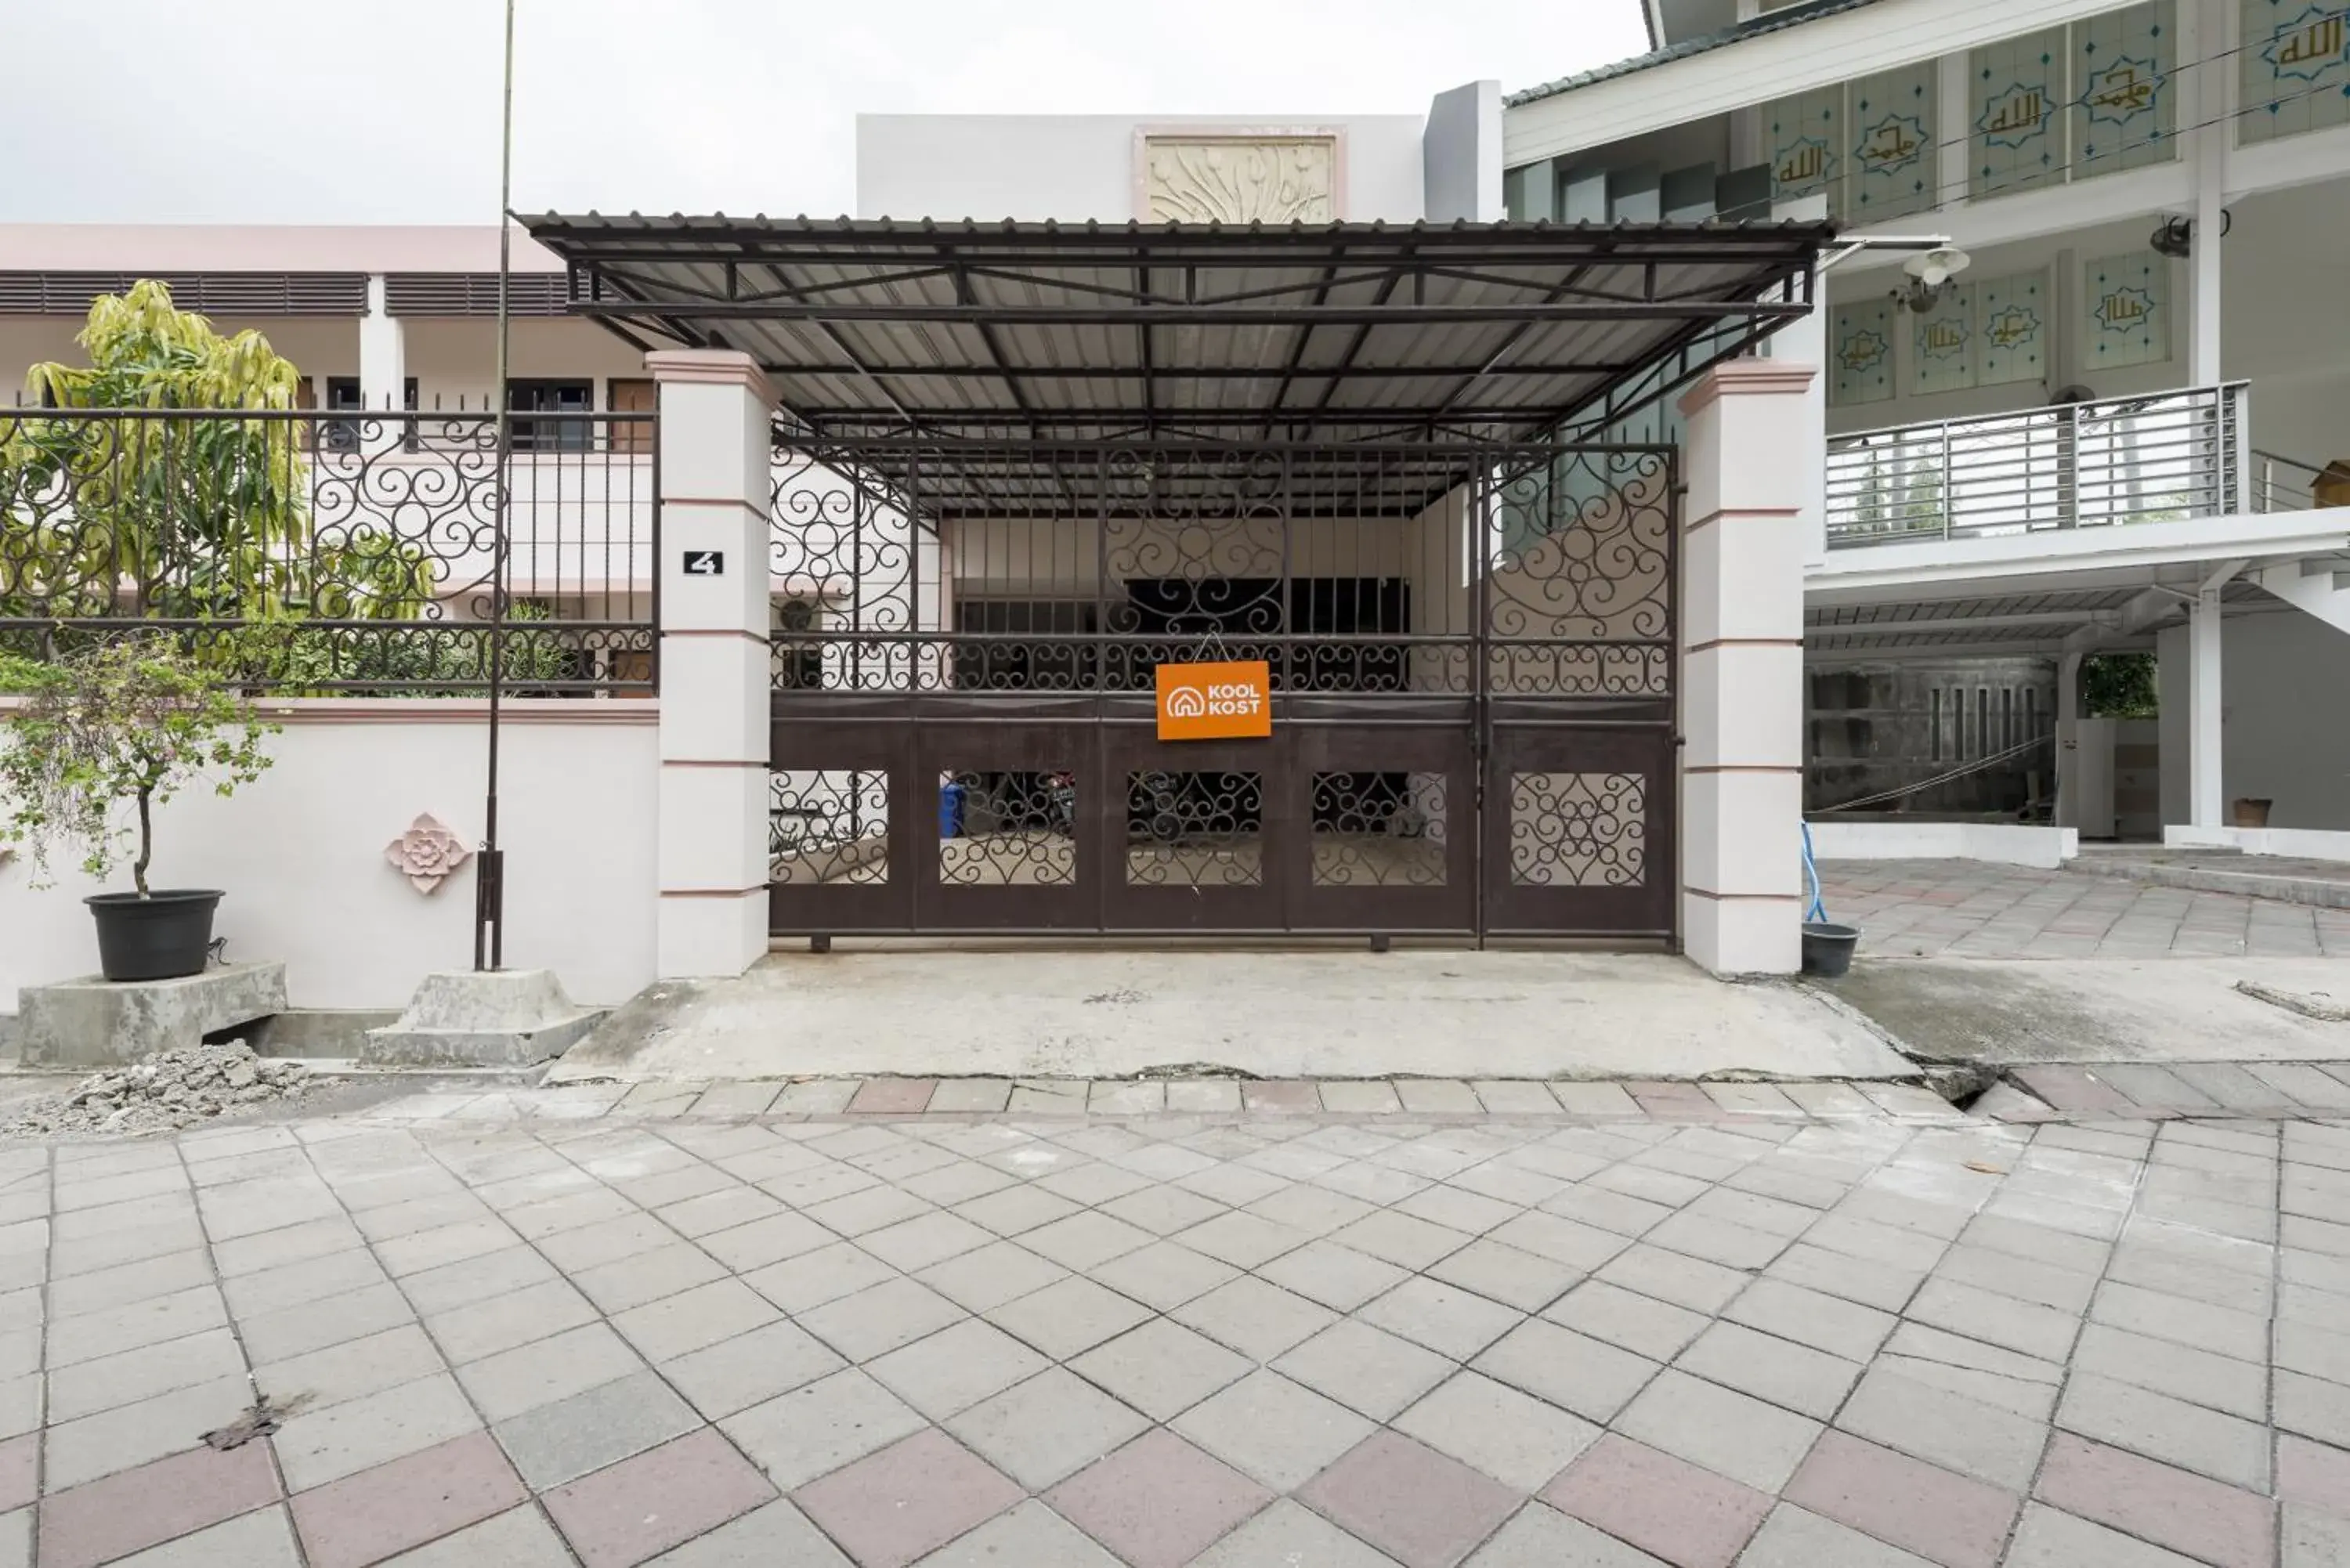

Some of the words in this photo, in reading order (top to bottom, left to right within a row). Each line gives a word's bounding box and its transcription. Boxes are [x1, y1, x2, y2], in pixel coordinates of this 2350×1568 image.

[691, 552, 716, 575] 4
[1208, 684, 1261, 699] KOOL
[1209, 700, 1261, 715] KOST
